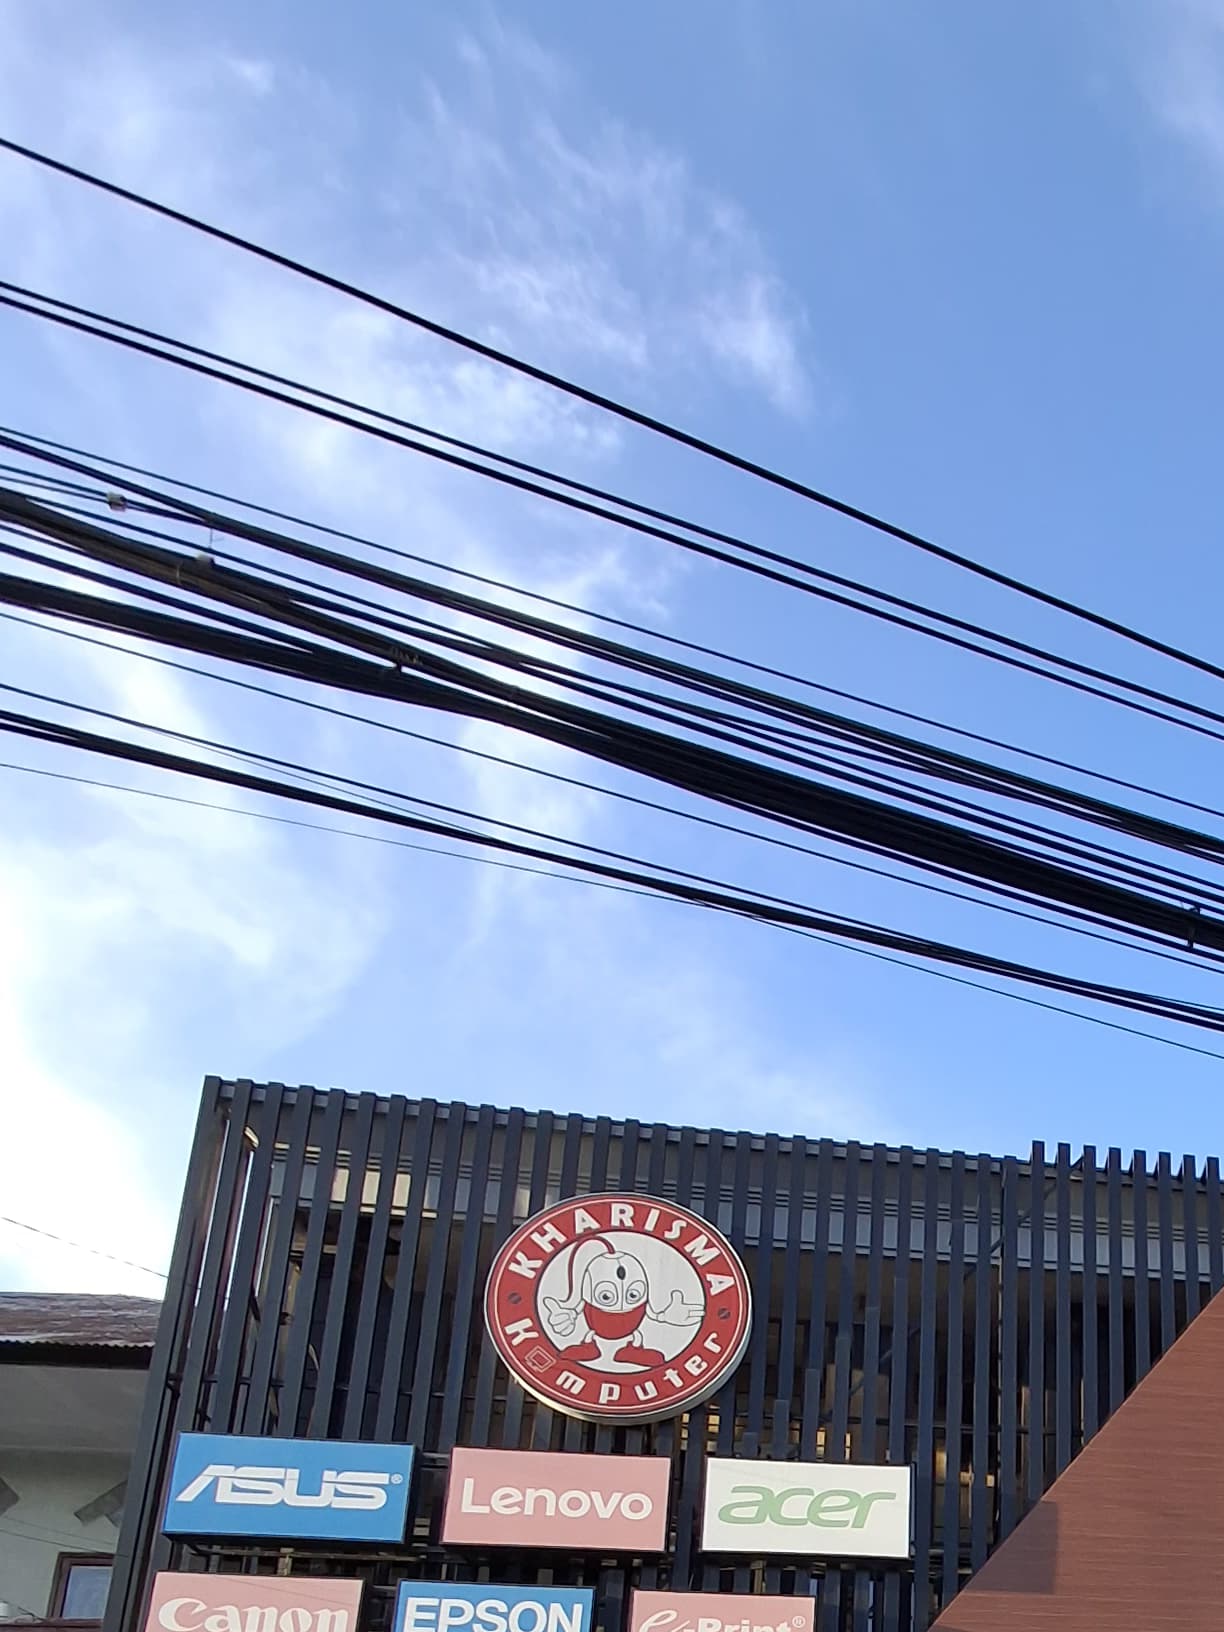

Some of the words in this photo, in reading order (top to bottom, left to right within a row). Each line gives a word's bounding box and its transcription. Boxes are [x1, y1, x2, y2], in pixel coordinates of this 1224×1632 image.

[508, 1202, 736, 1297] KHARISMA
[461, 1477, 654, 1521] Lenovo
[717, 1485, 897, 1530] acer
